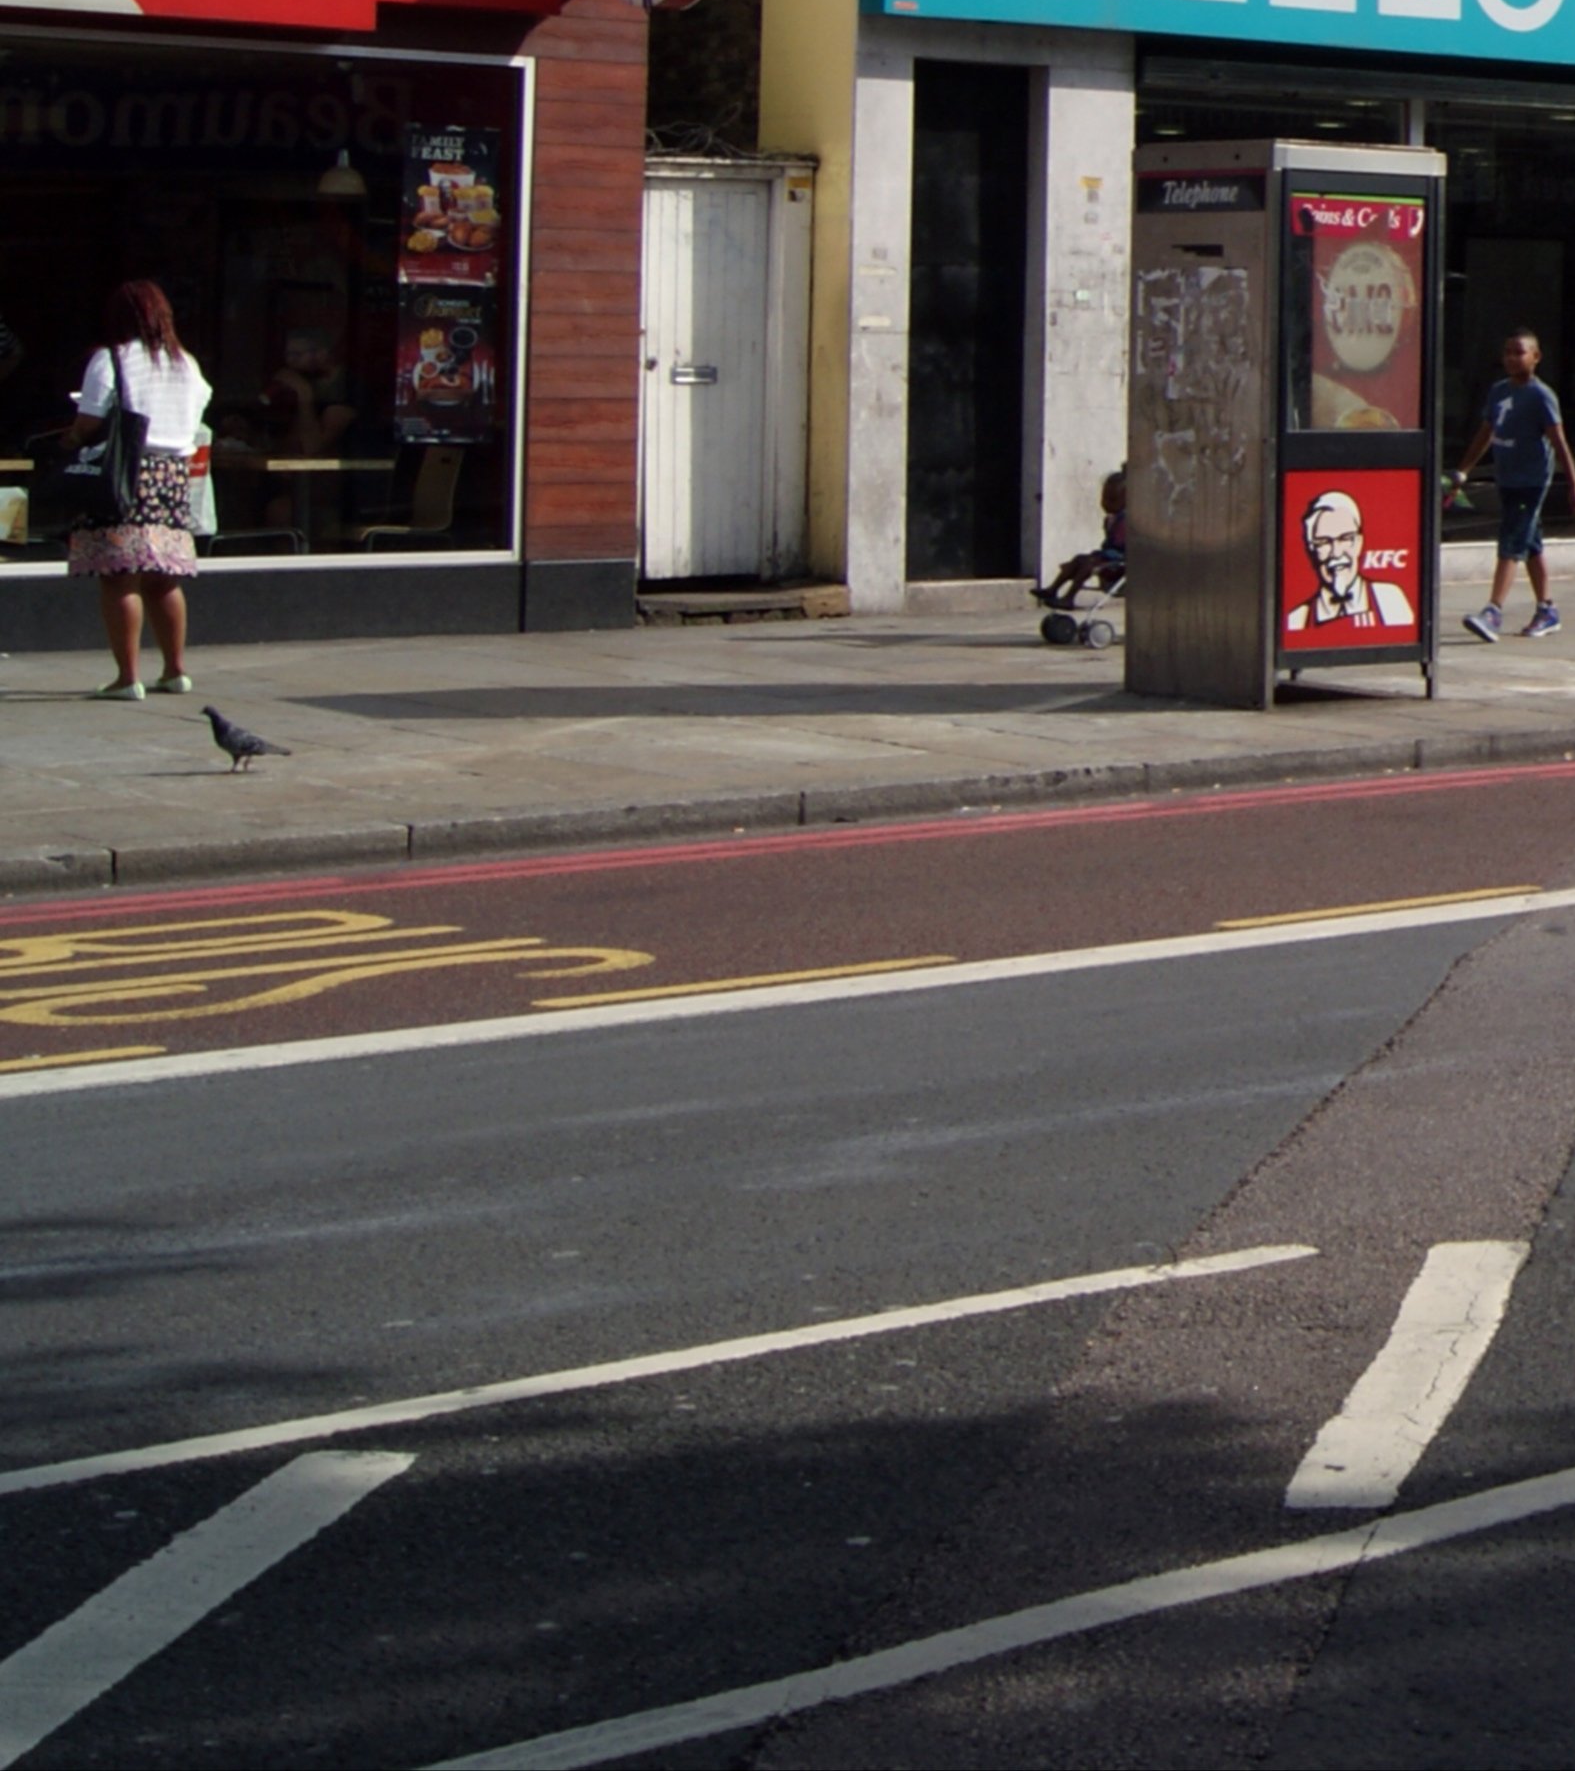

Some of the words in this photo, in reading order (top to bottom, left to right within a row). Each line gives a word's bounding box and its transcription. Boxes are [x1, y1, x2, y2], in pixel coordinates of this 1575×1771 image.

[411, 147, 466, 161] FEAST
[1162, 181, 1240, 209] Telephone
[1363, 549, 1409, 571] KFC
